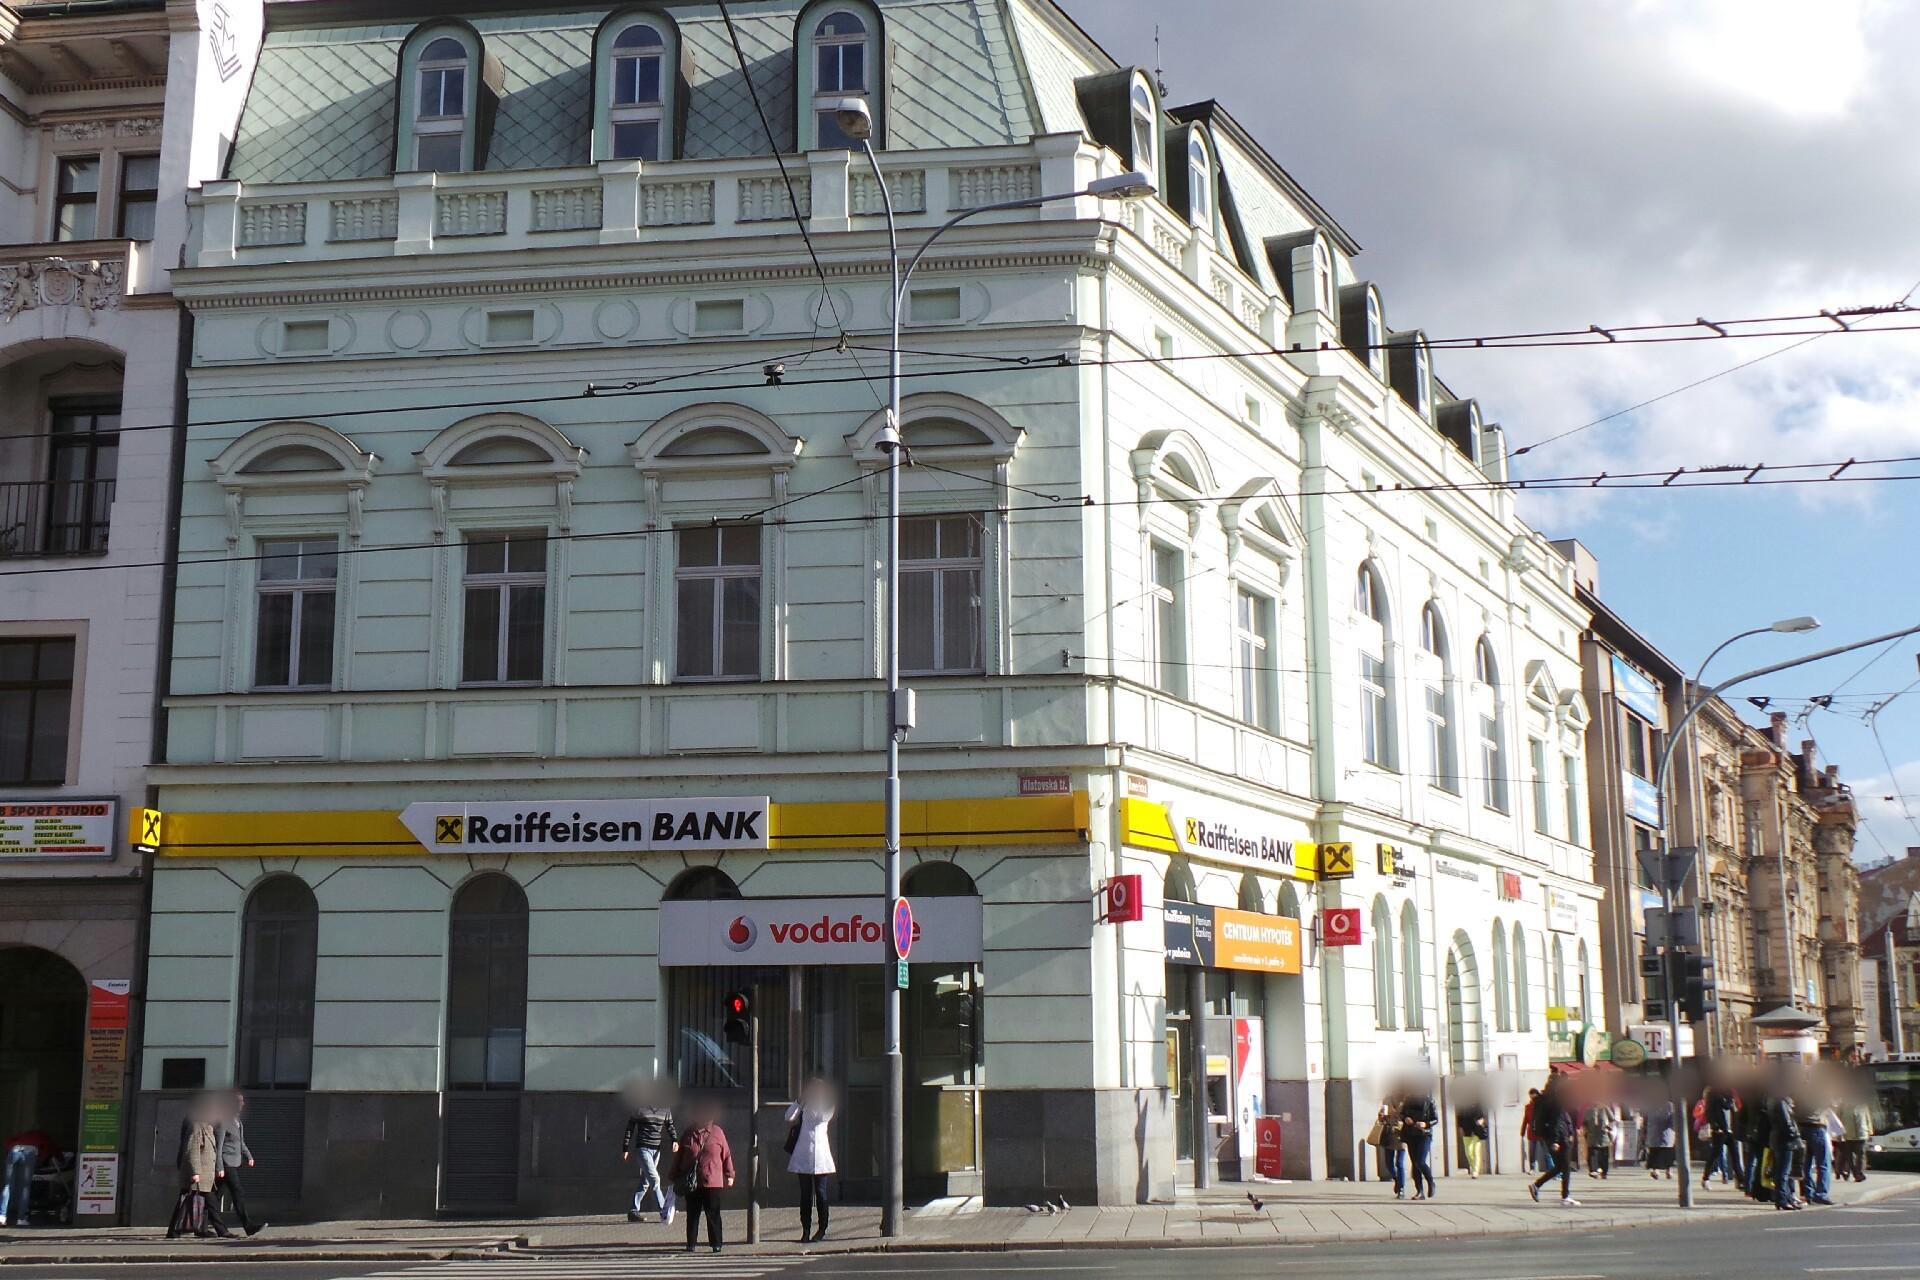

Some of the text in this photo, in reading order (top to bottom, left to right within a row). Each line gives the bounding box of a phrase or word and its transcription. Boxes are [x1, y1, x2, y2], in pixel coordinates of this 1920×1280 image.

[10, 805, 53, 817] SPORT
[56, 804, 105, 816] STUDIO
[467, 810, 762, 844] Raiffeisen BANK
[1198, 820, 1293, 866] Raiffeisen BANK
[1224, 922, 1293, 946] CENTRUM HYPOTÉK
[1645, 1031, 1662, 1053] T
